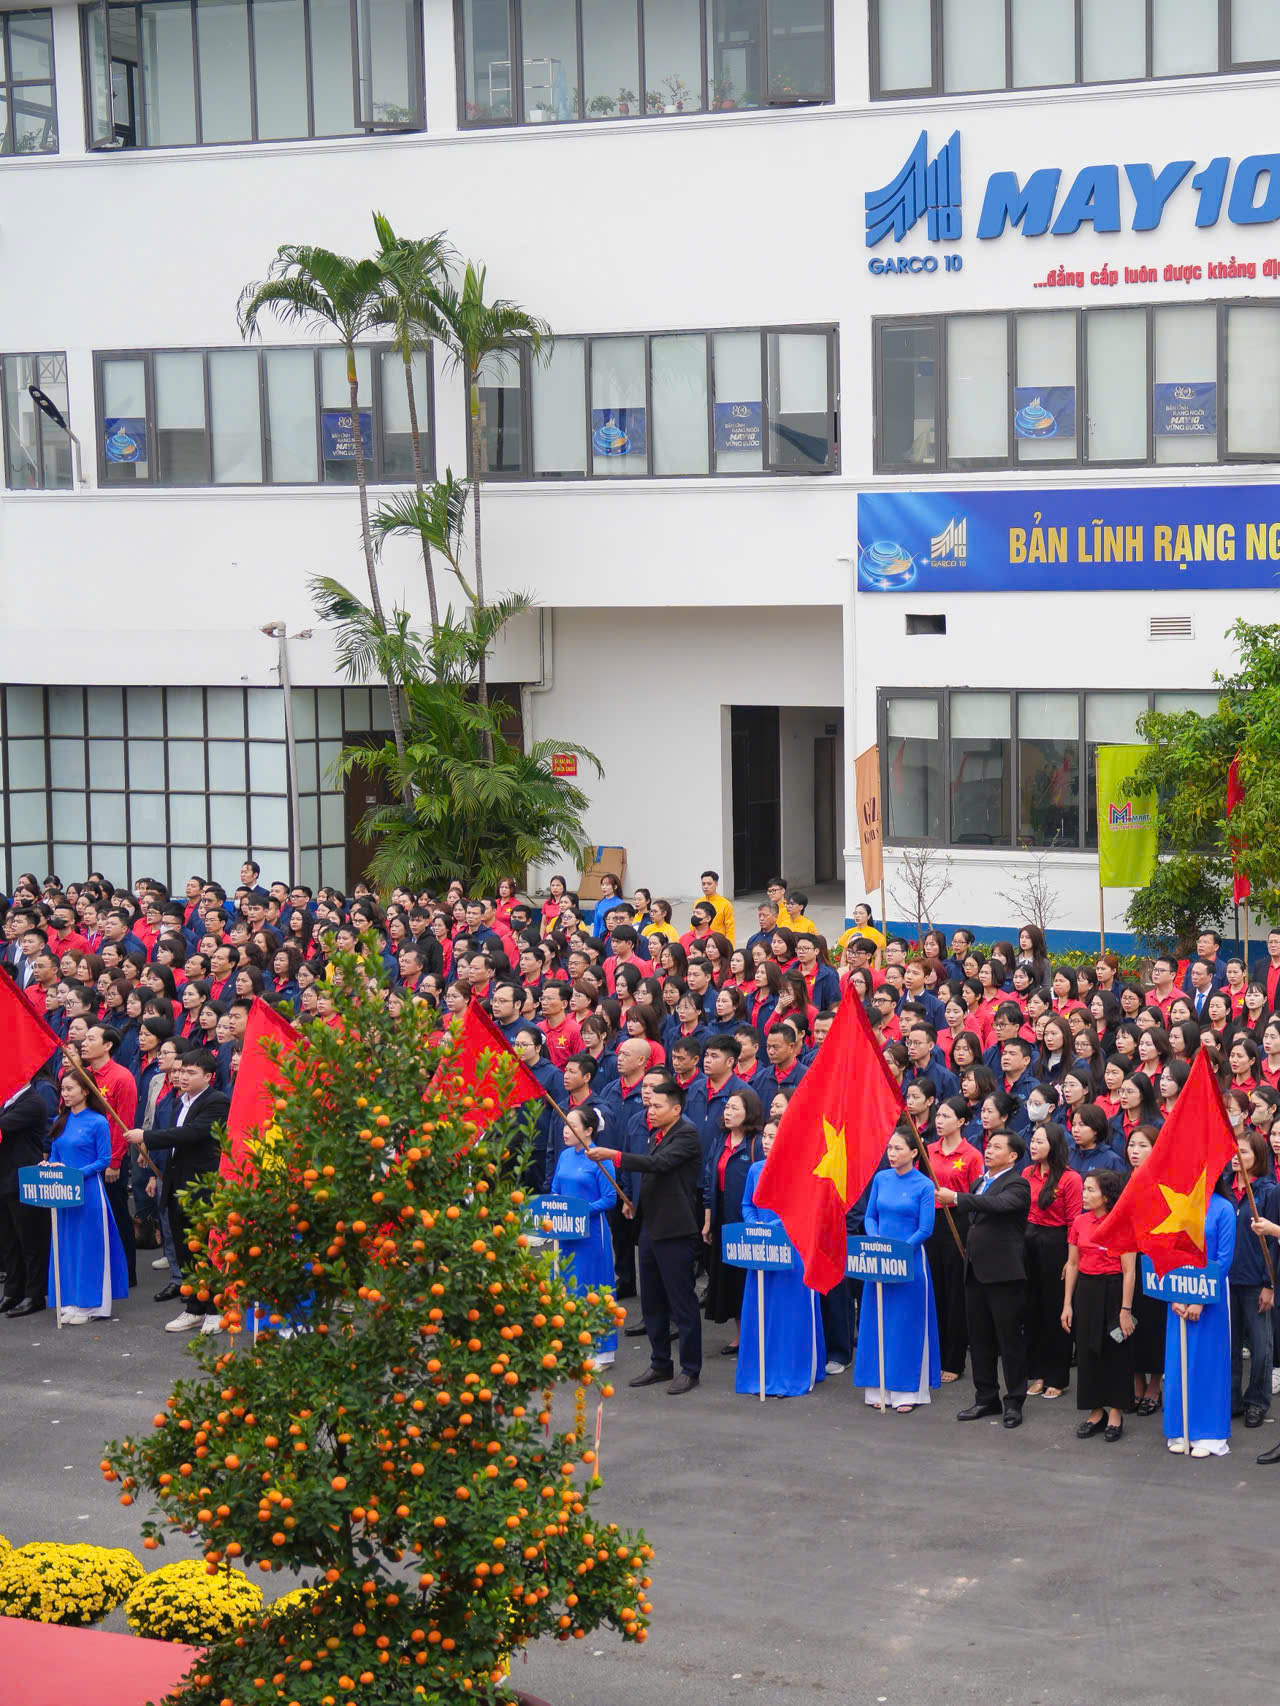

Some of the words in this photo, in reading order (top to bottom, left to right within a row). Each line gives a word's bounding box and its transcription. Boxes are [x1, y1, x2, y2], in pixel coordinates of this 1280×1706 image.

[868, 255, 938, 275] GARCO
[944, 253, 963, 273] 10
[1090, 263, 1119, 287] cấp
[1124, 265, 1158, 284] luôn
[1163, 263, 1202, 285] được
[1207, 256, 1257, 280] khẳng
[1008, 511, 1069, 564] BẢN
[1077, 519, 1144, 563] LĨNH
[1154, 522, 1236, 570] RẠNG
[39, 1169, 64, 1180] PHÒNG
[22, 1183, 37, 1202] THỊ
[39, 1180, 73, 1200] TRƯỜNG
[74, 1185, 81, 1201] 2
[541, 1200, 568, 1210] PHÒNG
[552, 1212, 573, 1234] QUÂN
[575, 1214, 586, 1236] SỰ
[745, 1226, 772, 1238] TRƯỜNG
[726, 1242, 737, 1260] CAO
[860, 1241, 892, 1253] TRƯỜNG
[847, 1251, 878, 1274] MẦM
[880, 1257, 907, 1277] NON
[1169, 1273, 1217, 1299] THUẬT
